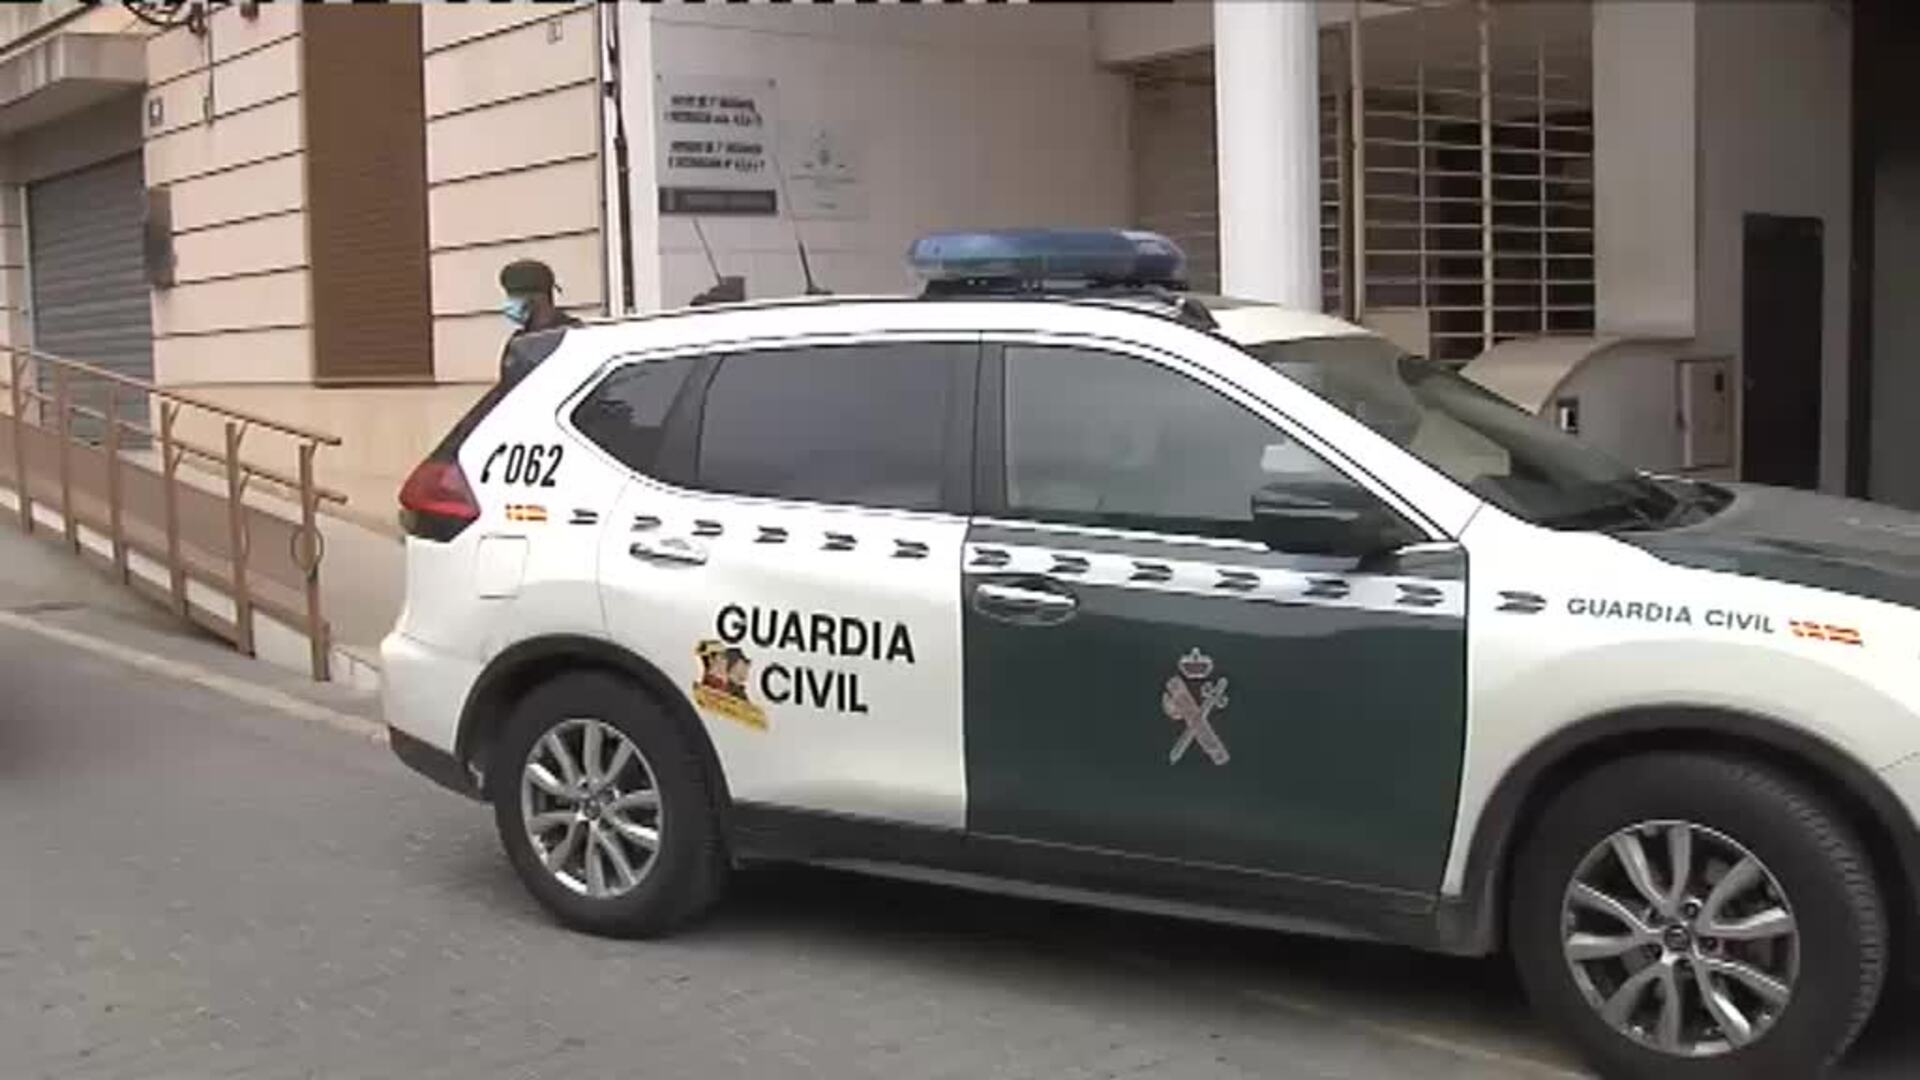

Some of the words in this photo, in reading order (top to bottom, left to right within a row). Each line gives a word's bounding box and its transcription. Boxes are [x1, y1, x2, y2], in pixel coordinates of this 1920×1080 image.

[504, 443, 564, 487] 062
[716, 604, 915, 664] GUARDIA
[1566, 597, 1692, 625] GUARDIA
[1704, 609, 1776, 634] CIVIL
[760, 663, 869, 714] CIVIL
